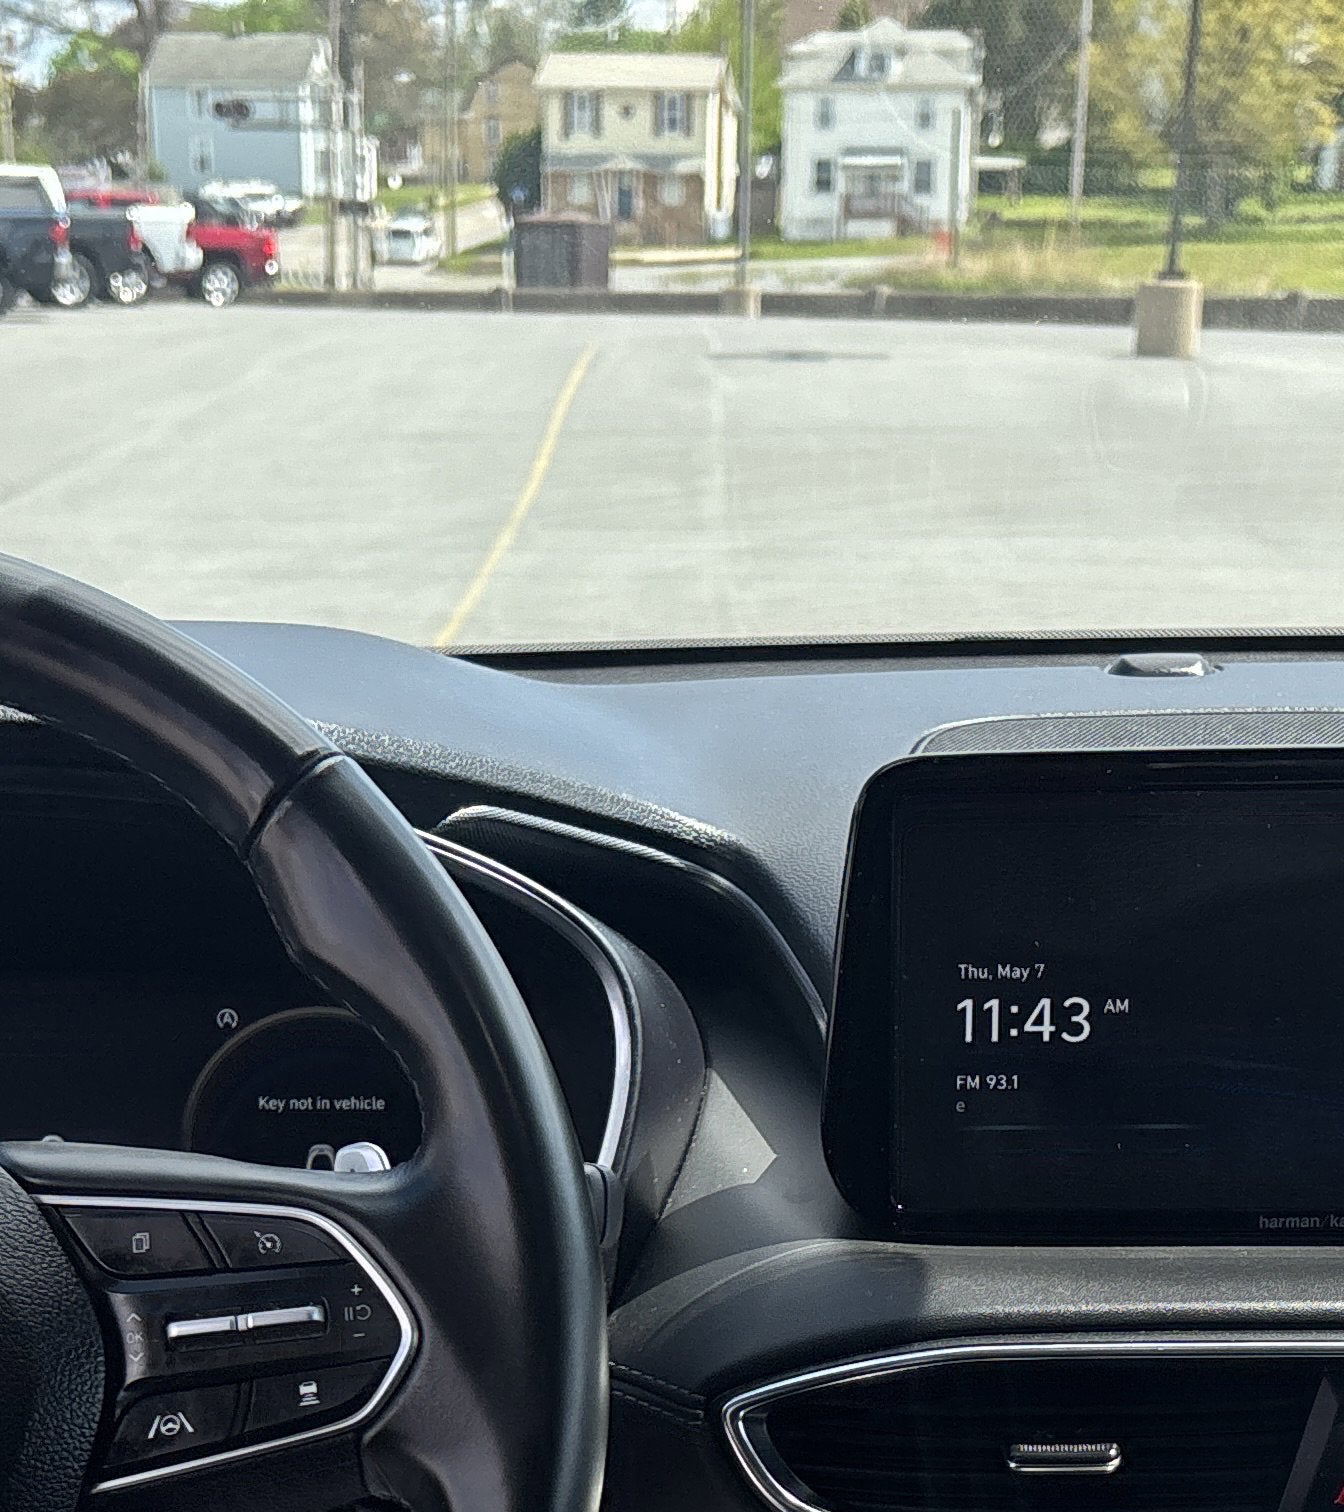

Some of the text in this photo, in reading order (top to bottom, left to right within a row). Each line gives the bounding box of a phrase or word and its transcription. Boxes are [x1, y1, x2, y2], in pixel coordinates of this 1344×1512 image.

[958, 963, 1045, 982] Thu, May 7
[956, 997, 1130, 1043] 11:43 AM
[956, 1074, 1019, 1091] FM 93.1
[258, 1096, 386, 1114] Key not in vehicle
